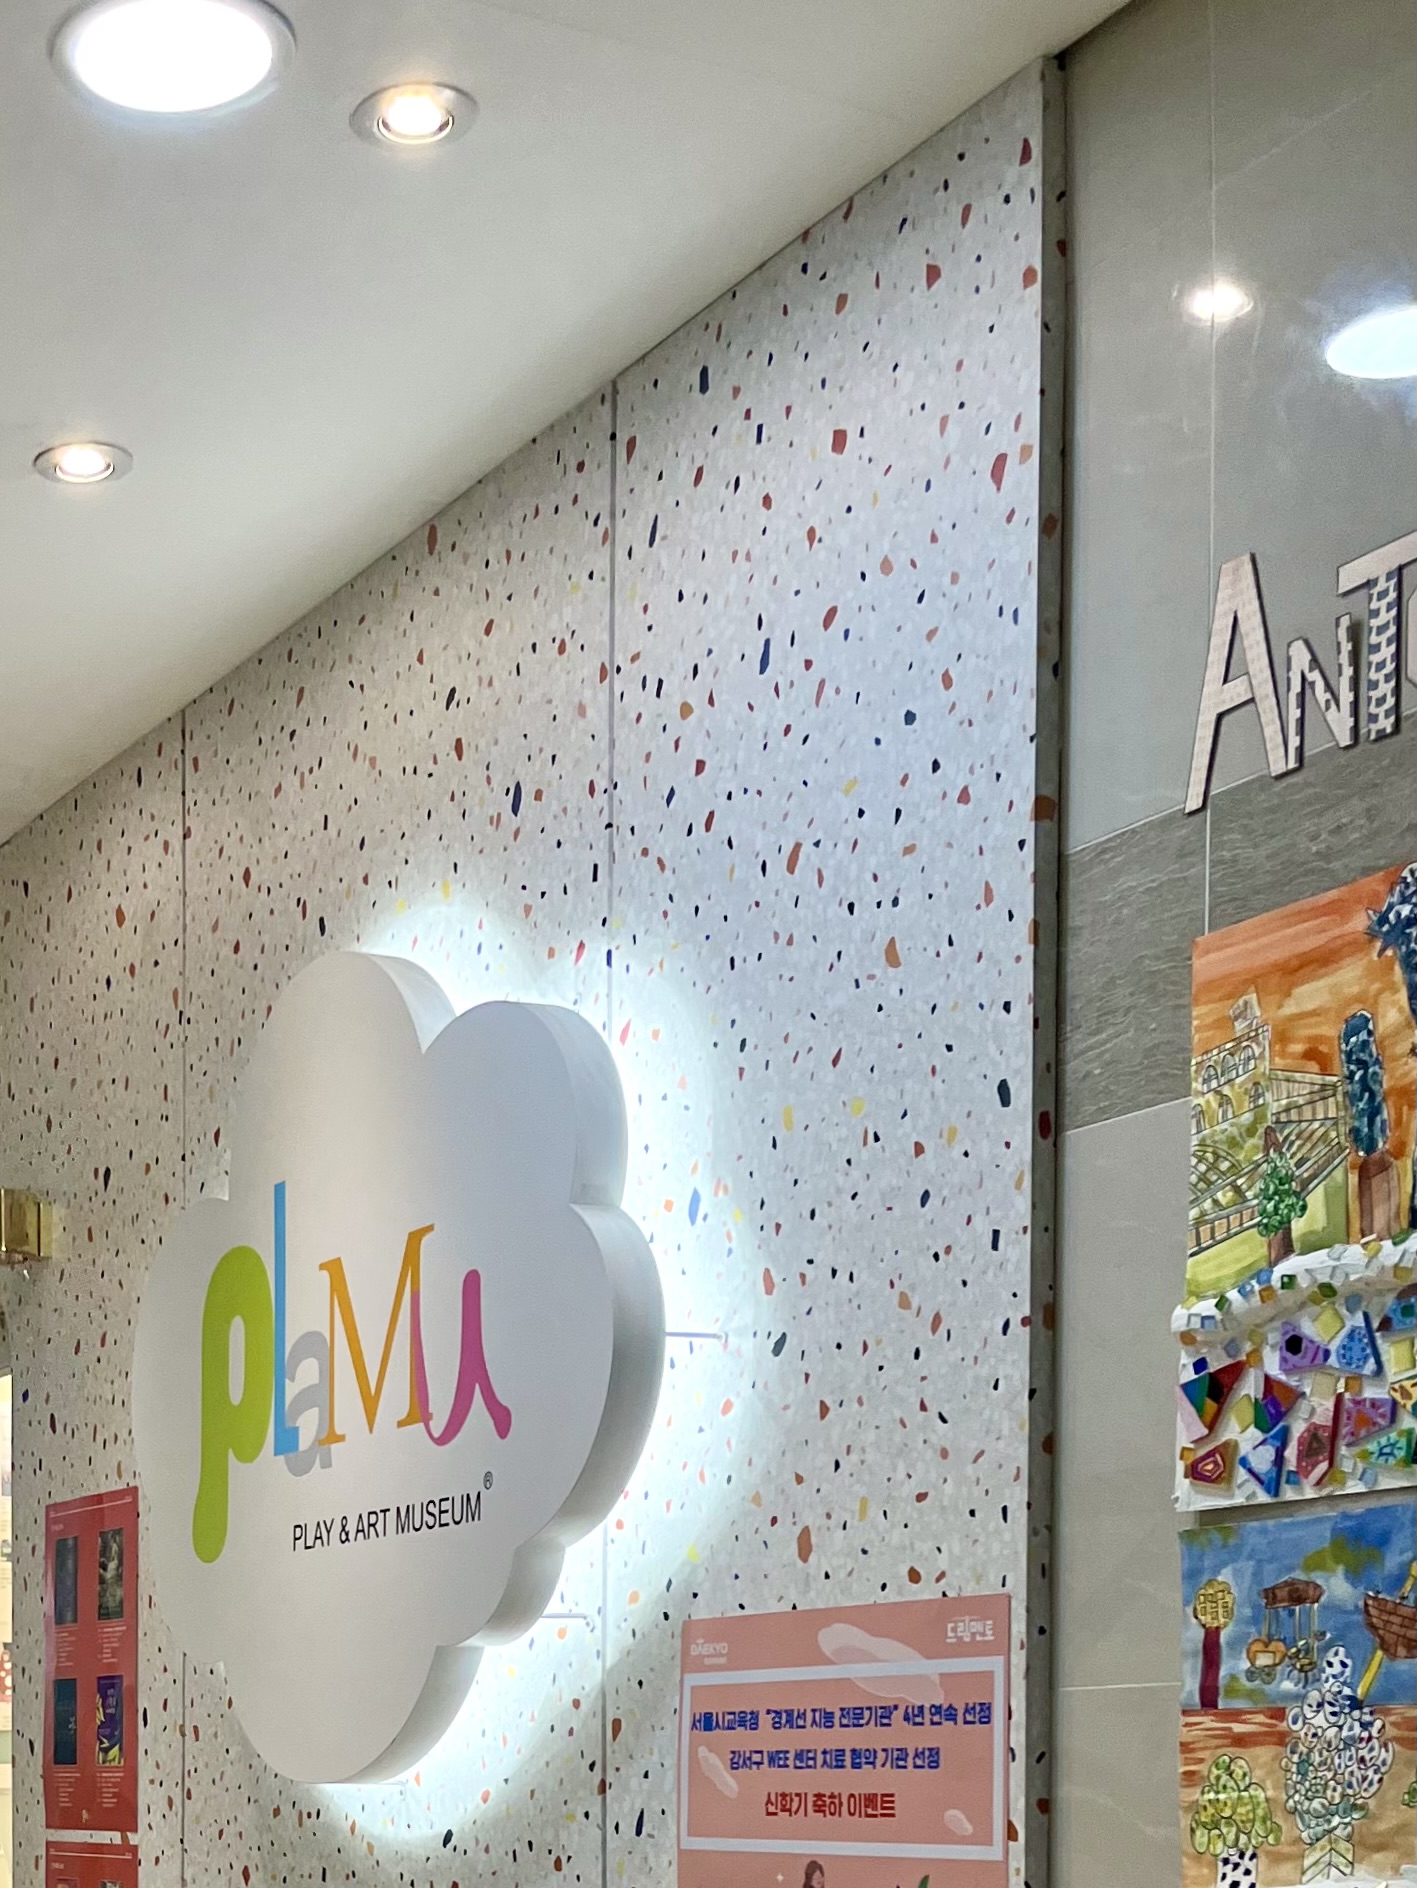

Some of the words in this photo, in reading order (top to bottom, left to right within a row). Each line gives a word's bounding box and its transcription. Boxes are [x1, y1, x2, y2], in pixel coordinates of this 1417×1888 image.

[292, 1516, 335, 1552] PLAY
[339, 1517, 351, 1544] &
[355, 1508, 391, 1541] ART
[946, 1617, 995, 1642] 드림멘토
[691, 1710, 760, 1732] 서울시교육청
[810, 1708, 835, 1729] 지능
[903, 1705, 925, 1726] 4년
[929, 1704, 958, 1726] 연속
[963, 1702, 992, 1725] 선정
[730, 1750, 764, 1770] 강서구
[767, 1750, 790, 1769] WEE
[793, 1749, 817, 1769] 센터
[821, 1748, 846, 1769] 치료
[850, 1748, 877, 1769] 협약
[881, 1748, 909, 1769] 기관
[912, 1747, 940, 1769] 선정
[765, 1791, 808, 1817] 신학기
[812, 1792, 843, 1818] 축하
[847, 1793, 896, 1818] 이벤트
